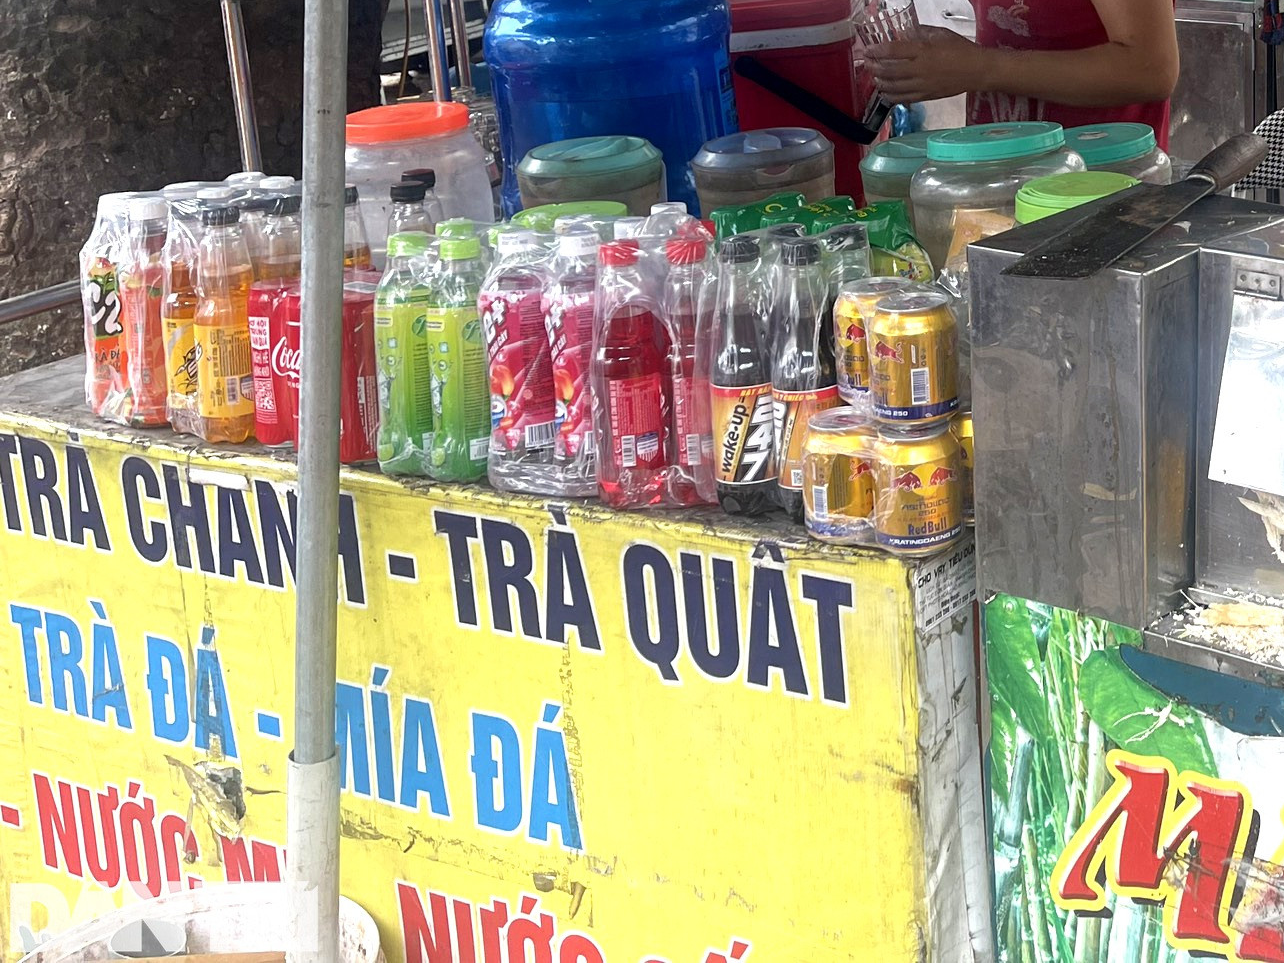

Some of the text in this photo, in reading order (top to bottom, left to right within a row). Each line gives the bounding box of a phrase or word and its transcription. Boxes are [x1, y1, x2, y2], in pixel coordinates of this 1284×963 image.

[0, 431, 112, 552] TRÀ
[121, 455, 366, 605] CHANH
[434, 503, 602, 651] TRÀ
[10, 600, 133, 729] TRÀ
[146, 626, 238, 759] ĐÁ
[470, 702, 584, 851] ĐÁ
[33, 772, 203, 901] NƯỚC
